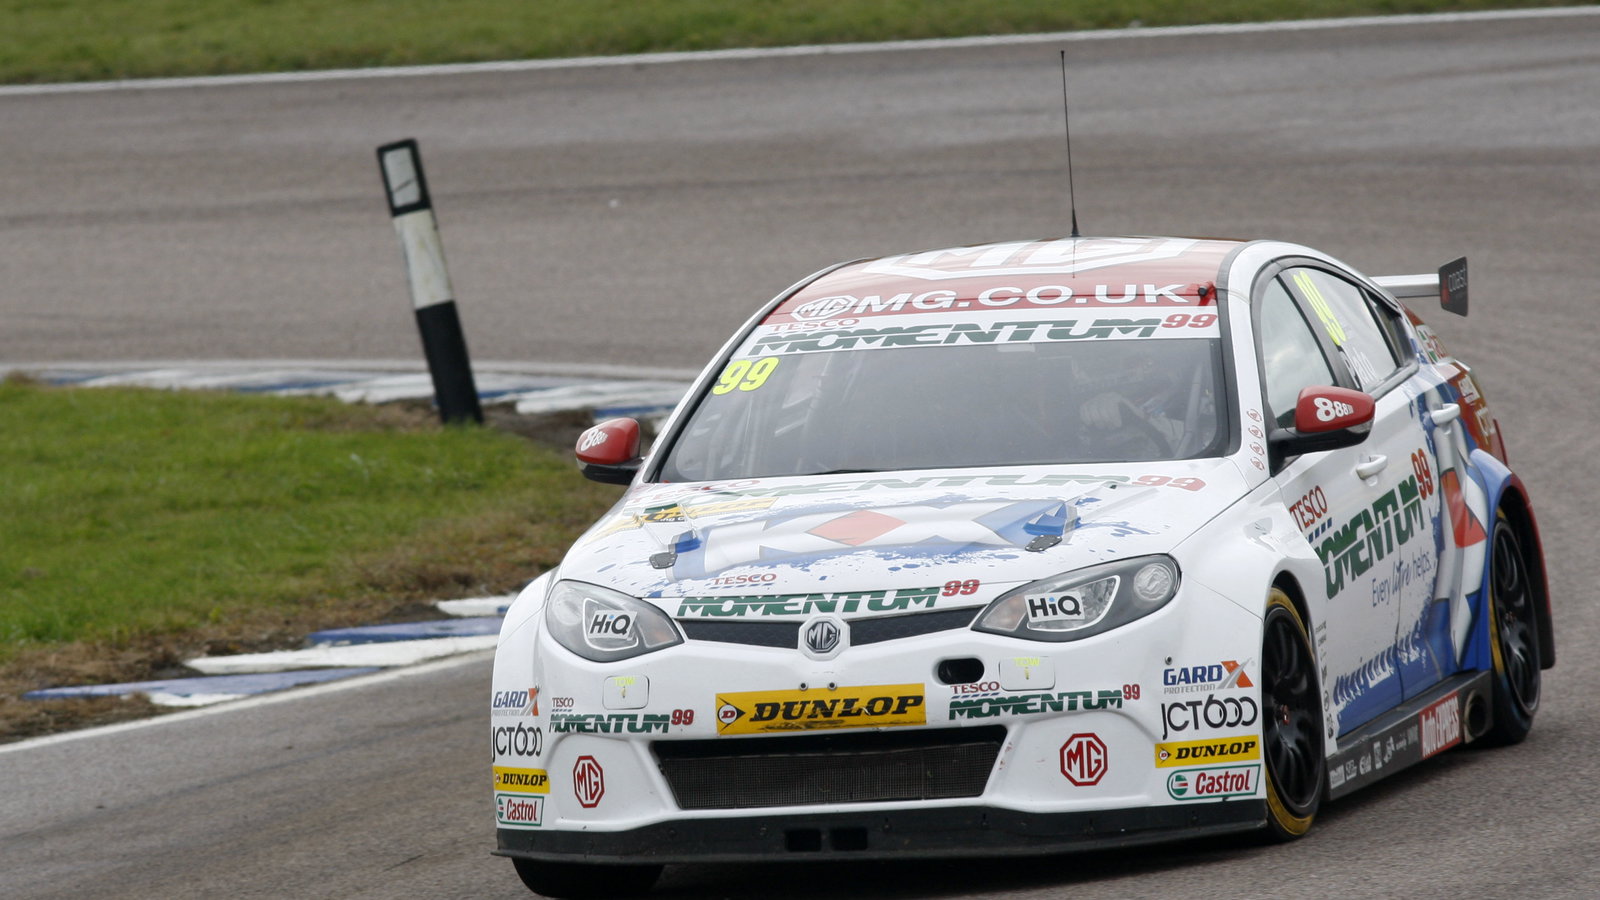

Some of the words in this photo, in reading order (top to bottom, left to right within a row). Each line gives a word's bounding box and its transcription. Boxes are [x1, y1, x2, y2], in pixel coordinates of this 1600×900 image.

[855, 284, 1190, 313] MG.CO.UK
[748, 318, 1161, 356] MOMENTUM
[1161, 313, 1218, 329] 99
[770, 318, 860, 331] TESCO
[712, 357, 780, 396] 99
[1131, 475, 1207, 491] 99
[1411, 448, 1434, 501] 99
[1289, 485, 1328, 533] TESCO
[711, 572, 777, 585] TESCO
[676, 586, 940, 617] MOMENTUM
[941, 579, 980, 597] 99
[1028, 595, 1082, 618] HiQ
[590, 613, 631, 637] HiQ
[807, 622, 839, 652] MG
[951, 681, 1000, 695] TESCO
[1164, 684, 1216, 695] PROTECTION
[552, 697, 574, 708] TESCO
[749, 695, 924, 722] DUNLOP
[949, 690, 1122, 720] MOMENTUM
[1123, 684, 1141, 700] 99
[549, 713, 670, 734] MOMENTUM
[671, 708, 695, 727] 99
[1161, 694, 1258, 740] JCT600
[1175, 741, 1256, 760] DUNLOP
[502, 773, 547, 787] DUNLOP
[1195, 769, 1250, 795] Castrol
[506, 798, 538, 822] Castrol
